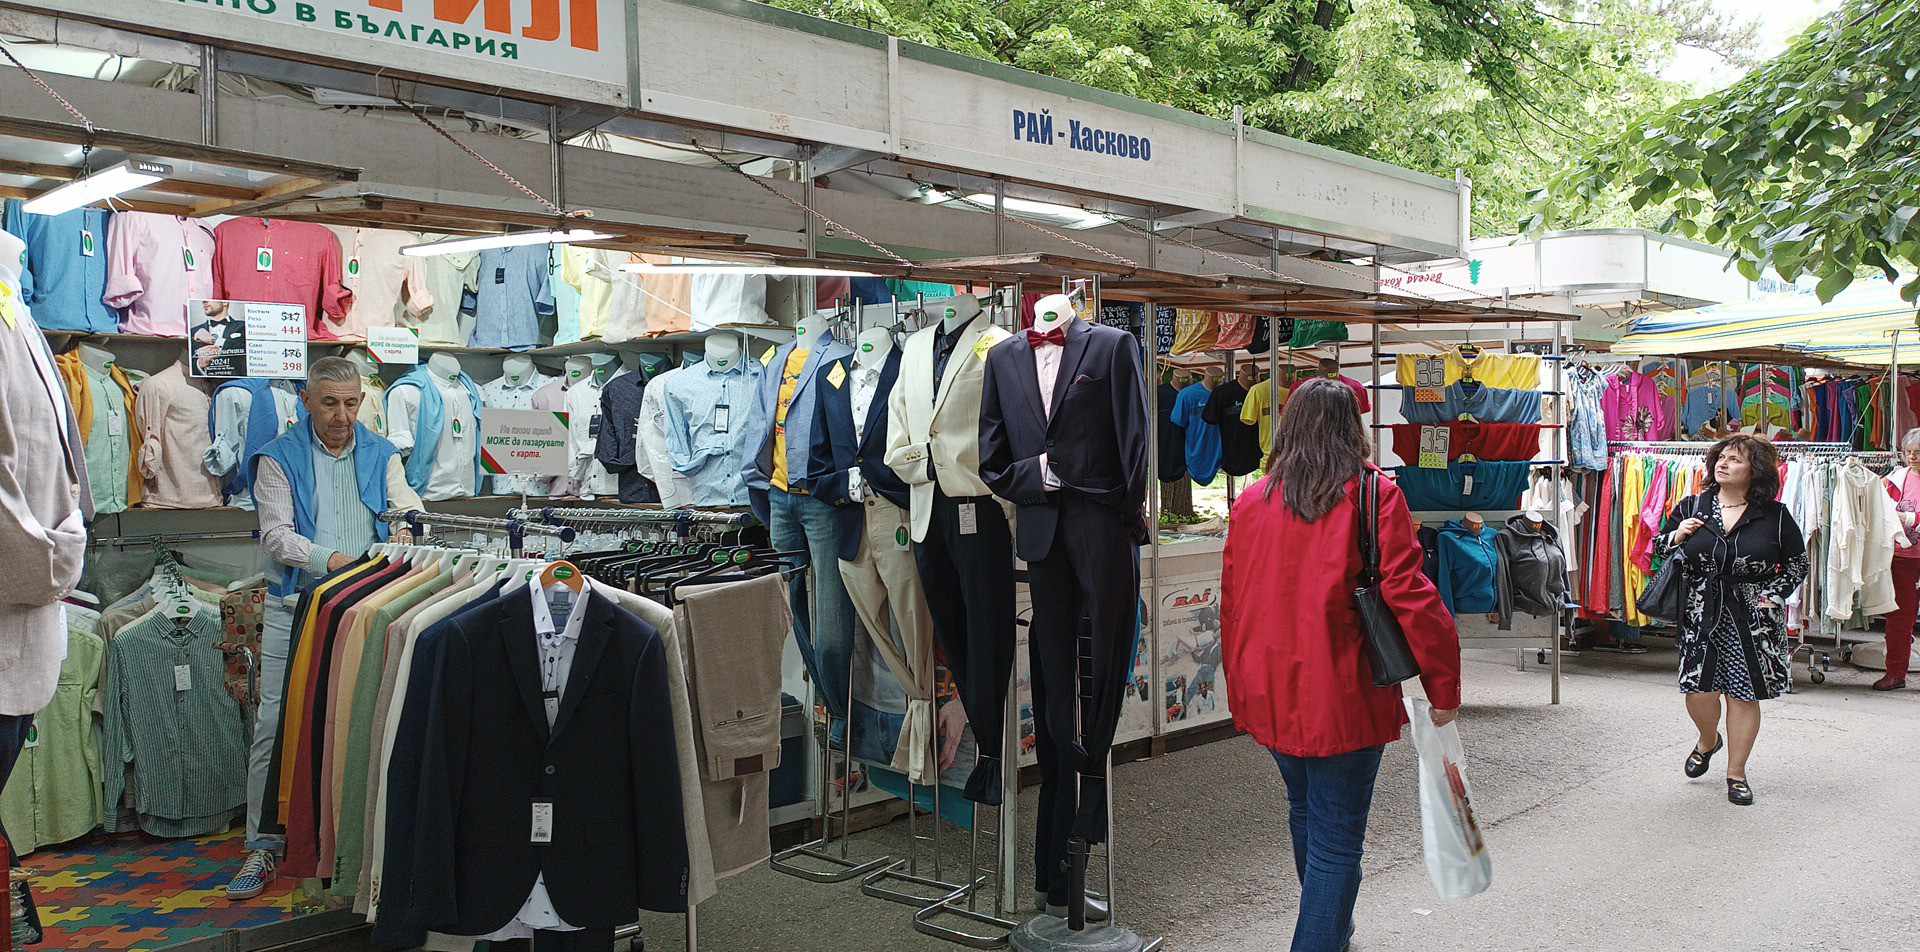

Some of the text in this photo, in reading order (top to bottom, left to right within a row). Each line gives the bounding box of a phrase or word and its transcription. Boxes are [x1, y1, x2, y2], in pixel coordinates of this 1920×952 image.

[296, 2, 316, 22] В
[335, 11, 519, 59] БЪЛГАРИЯ
[1013, 108, 1053, 145] РАЙ
[1069, 119, 1151, 161] Хасково
[281, 325, 302, 335] 444
[282, 362, 302, 371] 398
[1416, 359, 1445, 388] 35
[486, 436, 565, 448] МОЖЕ да пазарувате
[1421, 427, 1449, 453] 35
